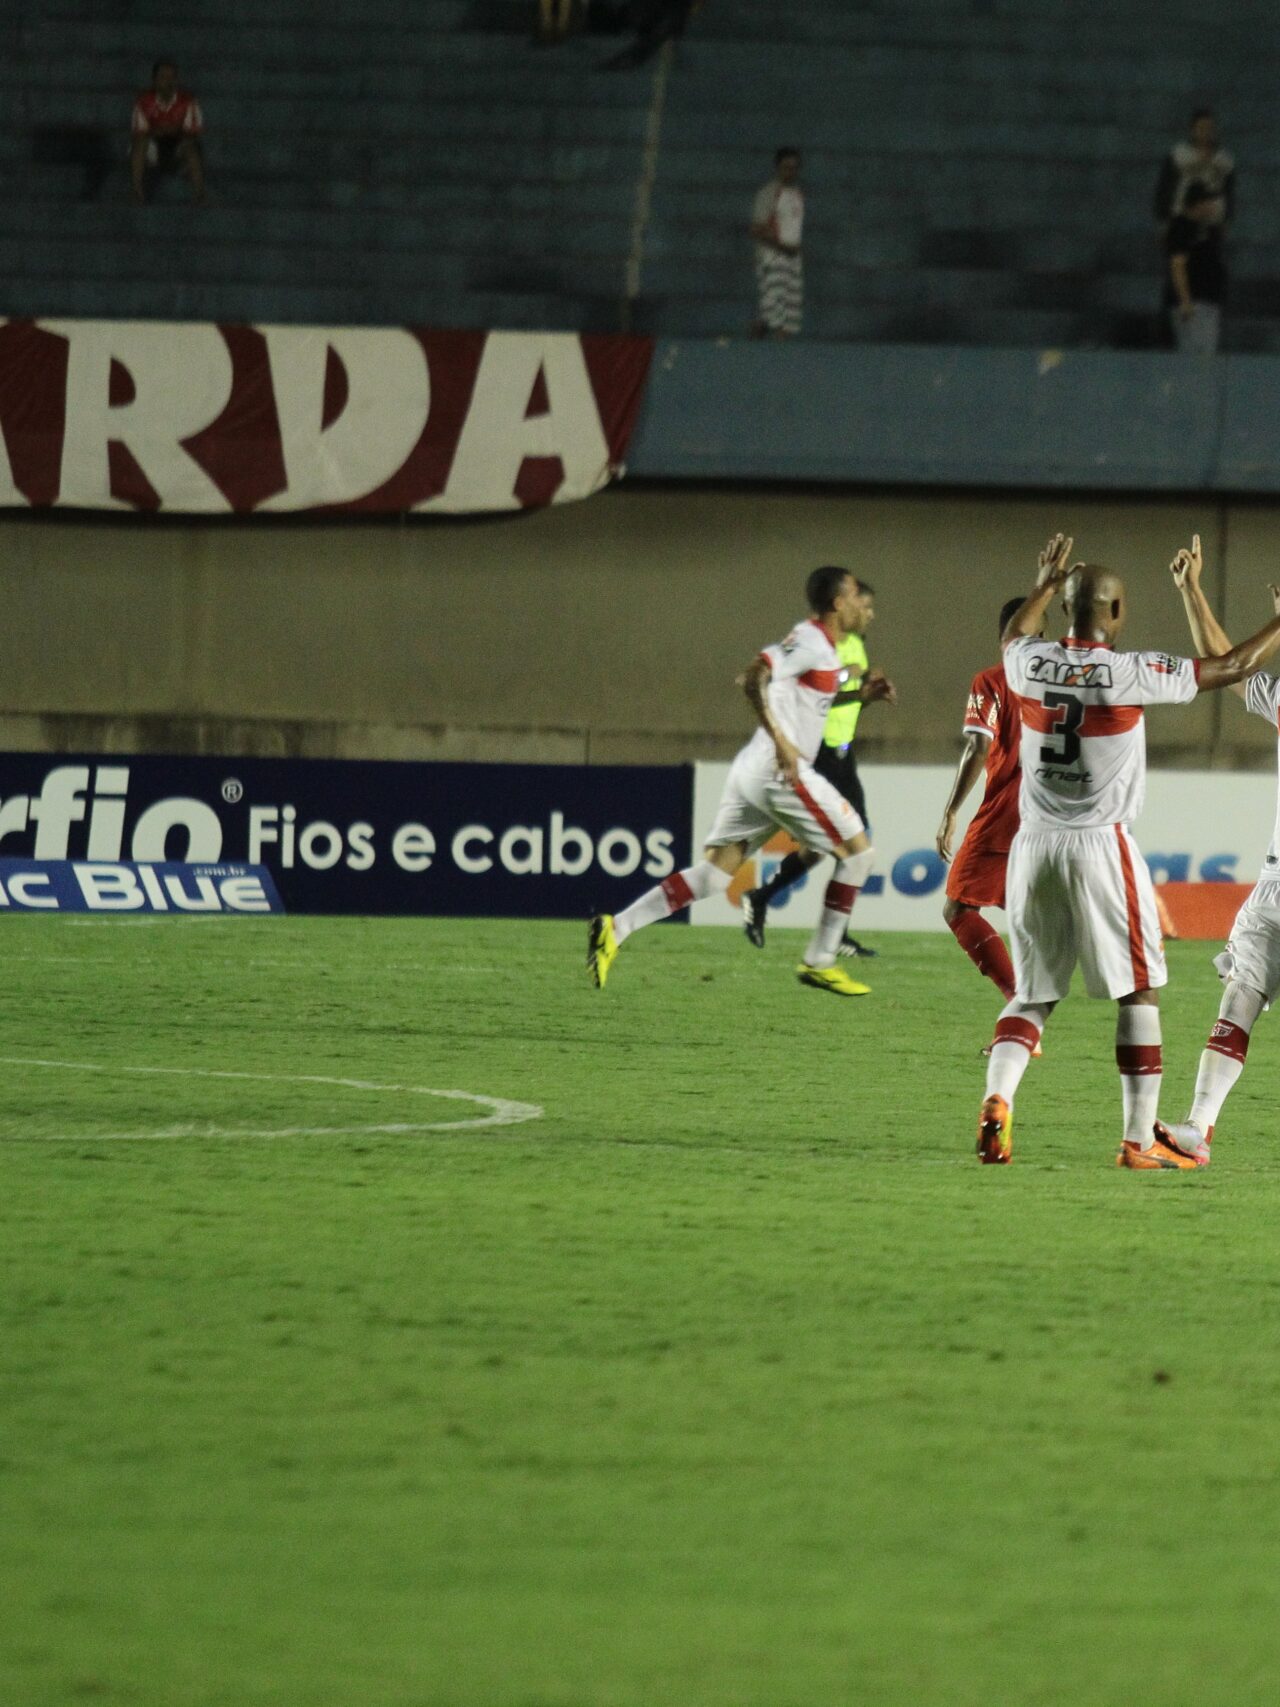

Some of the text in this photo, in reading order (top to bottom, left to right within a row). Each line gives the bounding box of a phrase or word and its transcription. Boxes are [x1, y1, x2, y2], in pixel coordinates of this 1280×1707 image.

[0, 317, 610, 513] RDA
[1025, 656, 1112, 689] CAIXA
[1040, 691, 1085, 765] 3
[249, 804, 675, 878] Fios e cabos
[72, 863, 272, 912] Blue
